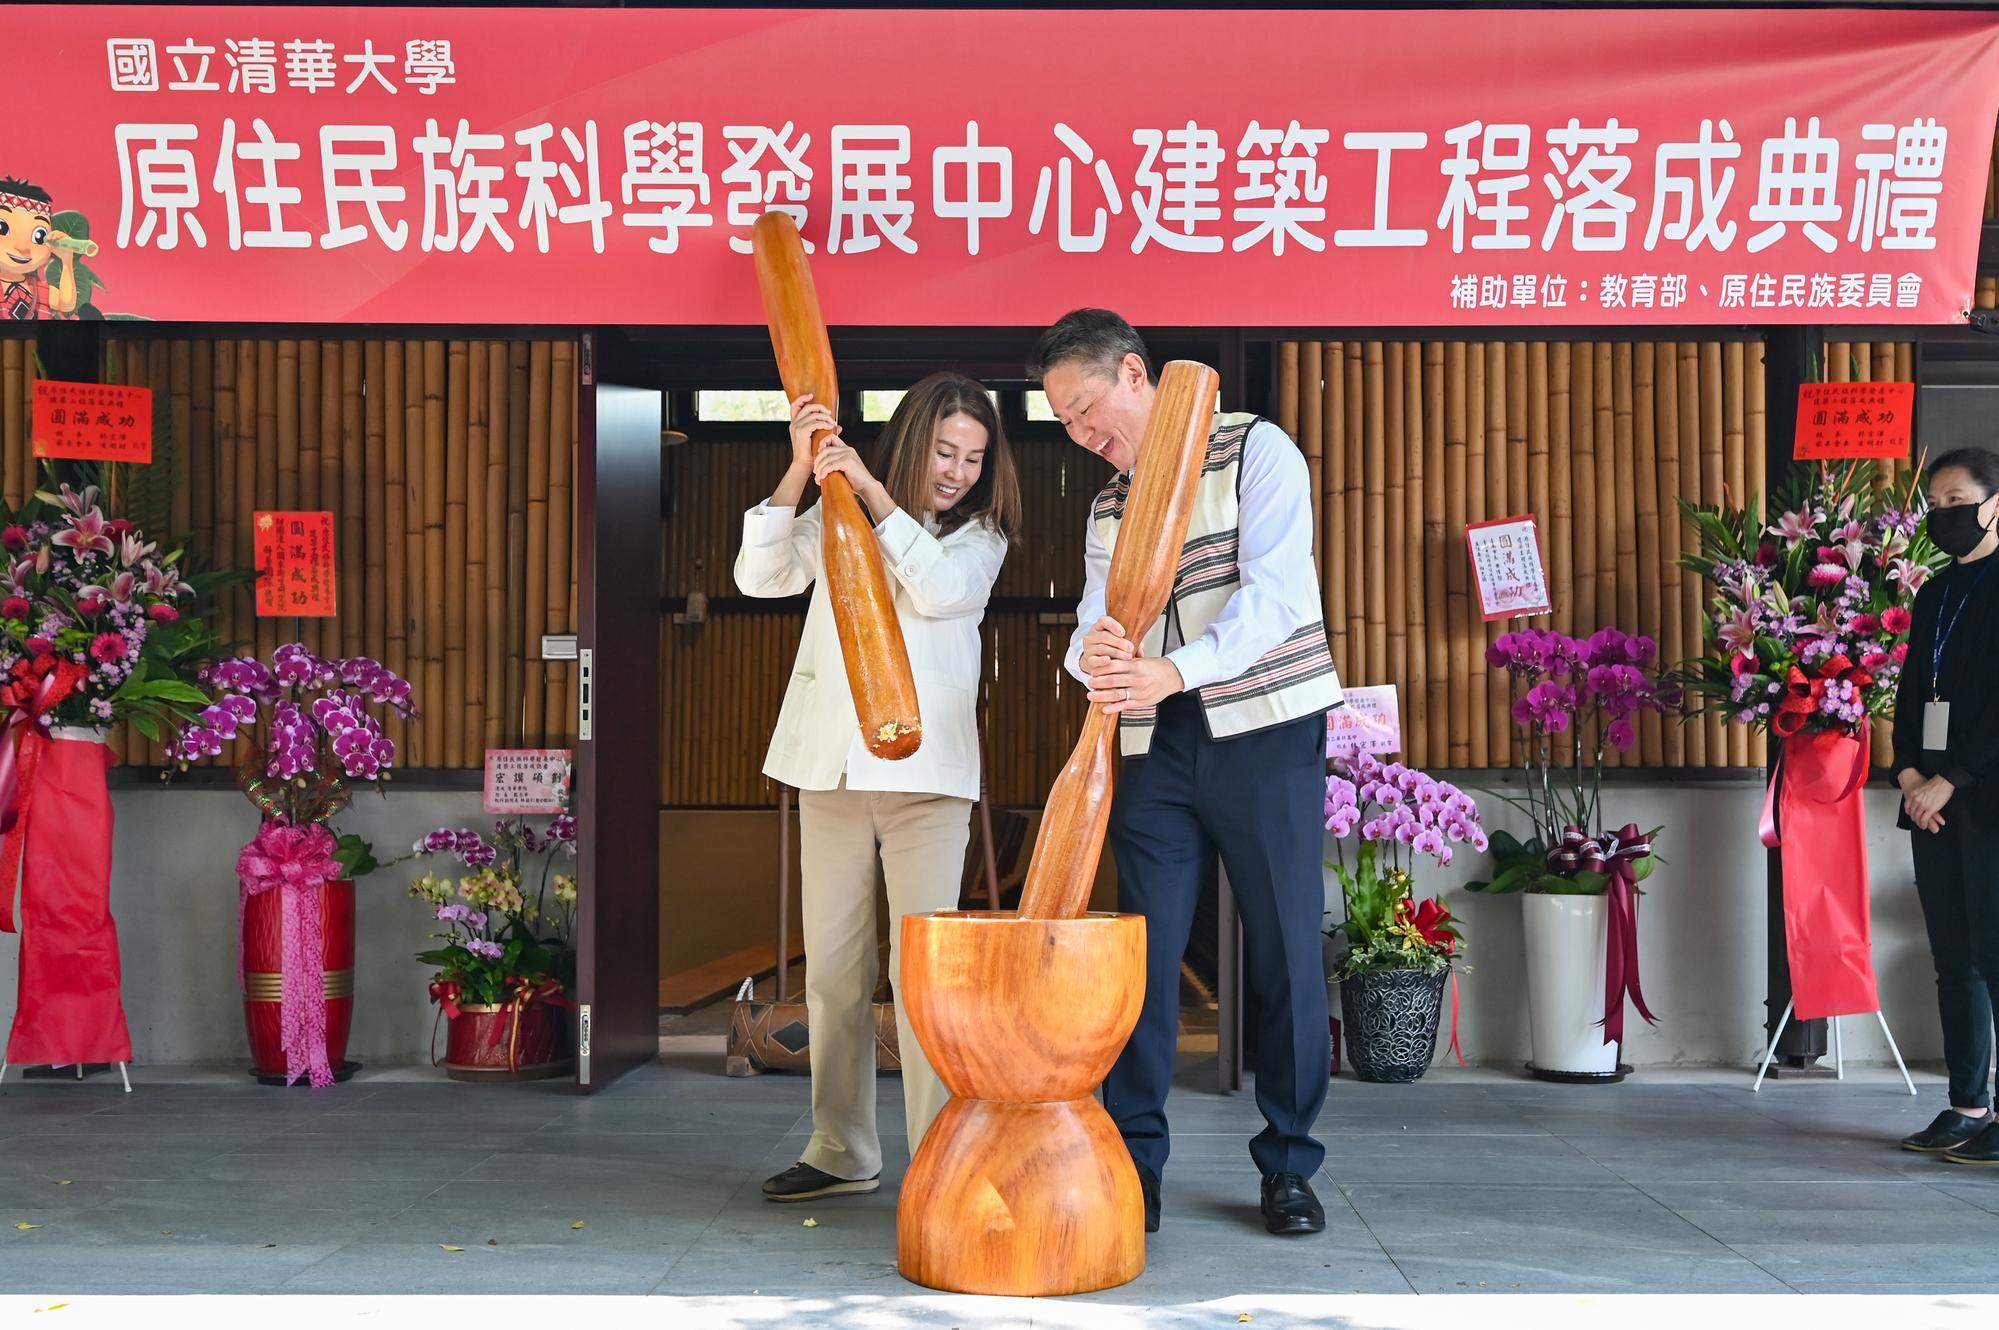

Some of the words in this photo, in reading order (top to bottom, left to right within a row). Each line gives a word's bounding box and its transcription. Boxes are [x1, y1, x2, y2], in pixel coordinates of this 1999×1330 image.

[107, 37, 457, 96] 國立清華大學
[115, 116, 1947, 257] 原住民族科學發展中心建築工程落成典禮
[1450, 271, 1923, 310] 補助單位：教育部、原住民族委員會
[51, 409, 134, 428] 圓滿成功
[1813, 409, 1894, 425] 圓滿成功
[290, 521, 308, 605] 圓滿成功
